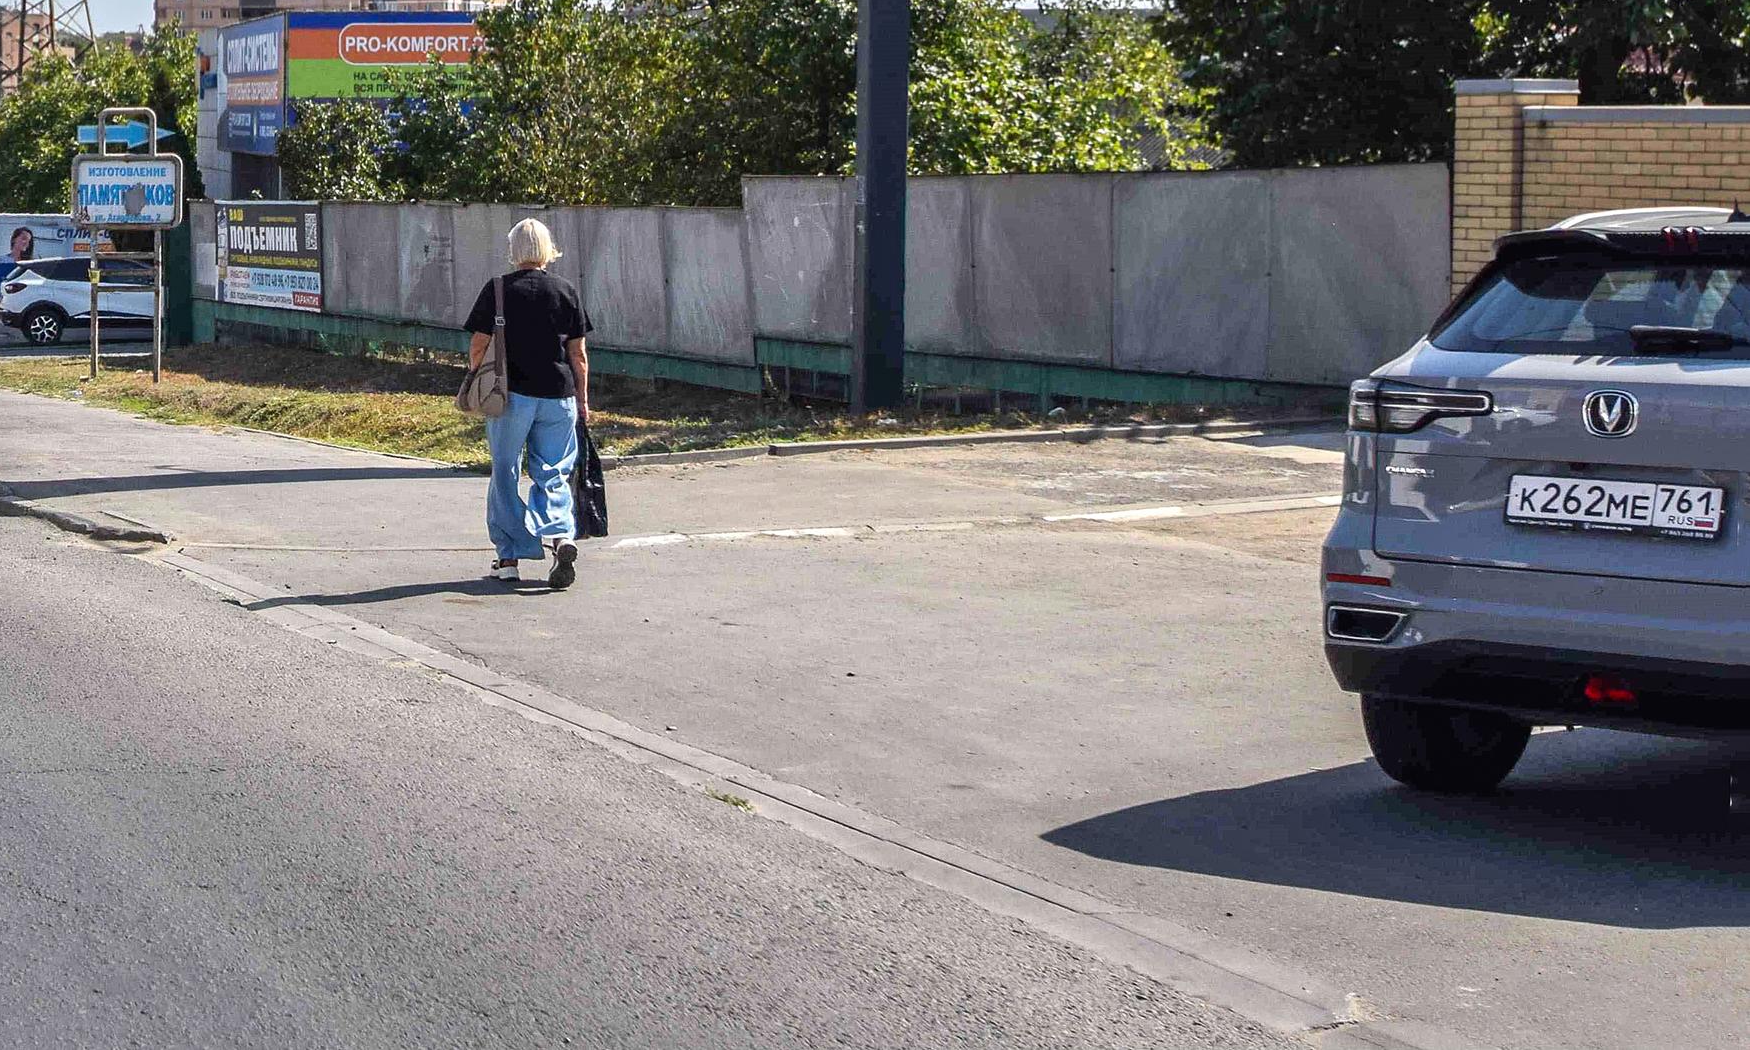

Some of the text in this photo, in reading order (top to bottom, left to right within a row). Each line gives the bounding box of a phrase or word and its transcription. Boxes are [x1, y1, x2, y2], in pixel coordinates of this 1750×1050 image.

[353, 71, 368, 81] НА
[88, 167, 167, 178] ИЗГОТОВЛЕНИЕ
[78, 184, 176, 206] ПАМЯТКОВ
[229, 225, 298, 254] ПОДЪЕМНИК
[1659, 487, 1712, 517] 761
[1666, 515, 1695, 527] RUS
